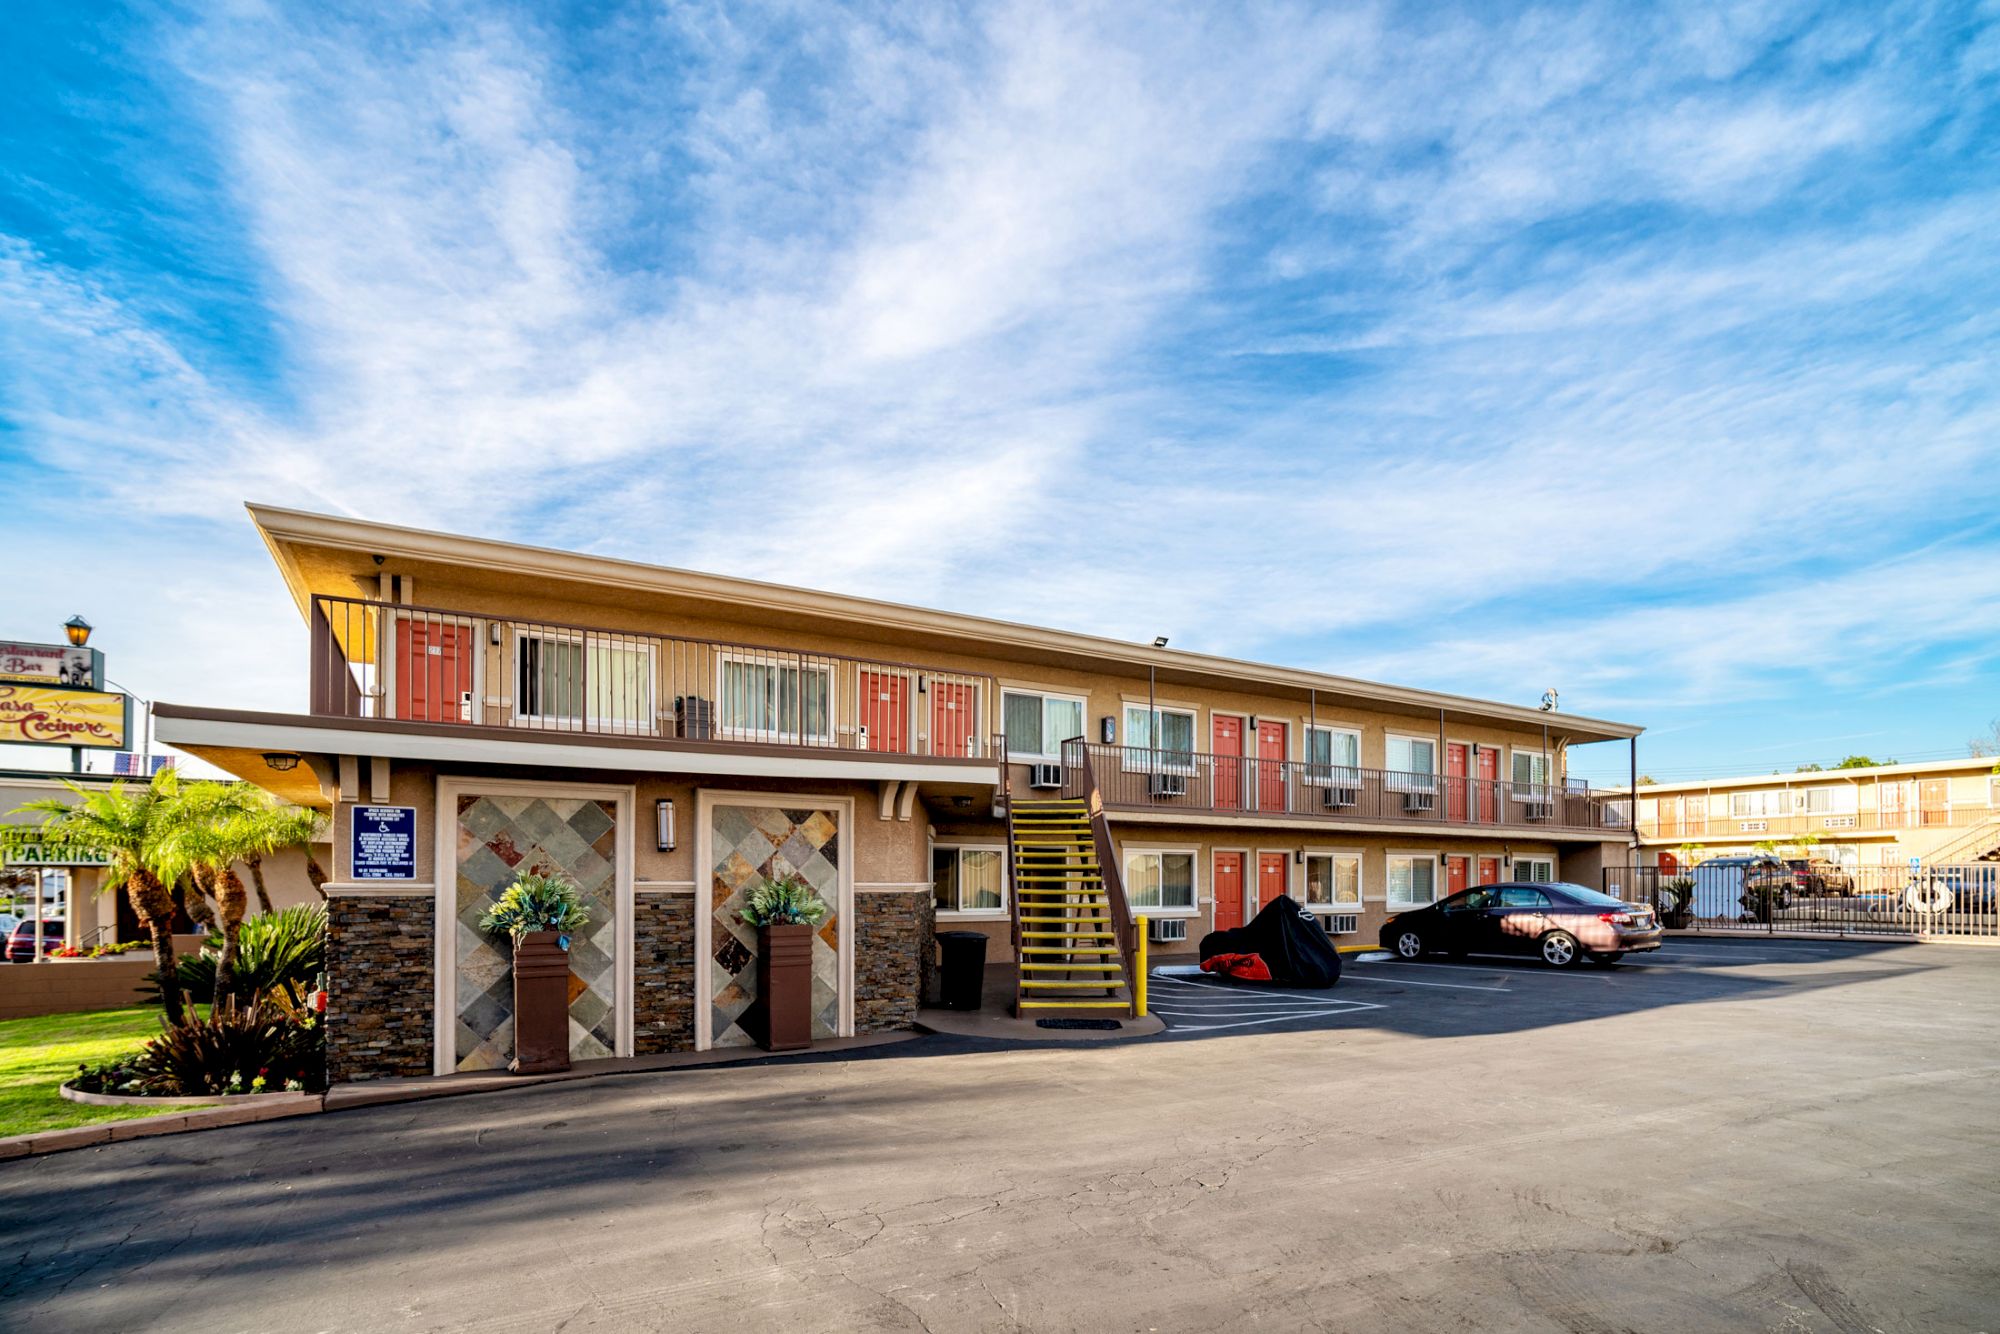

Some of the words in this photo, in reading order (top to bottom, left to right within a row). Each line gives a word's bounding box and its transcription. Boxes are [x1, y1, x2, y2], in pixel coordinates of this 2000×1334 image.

[0, 645, 66, 659] estaurant
[4, 658, 43, 673] Bar
[19, 712, 113, 741] Cocinero
[12, 846, 107, 862] PARKING
